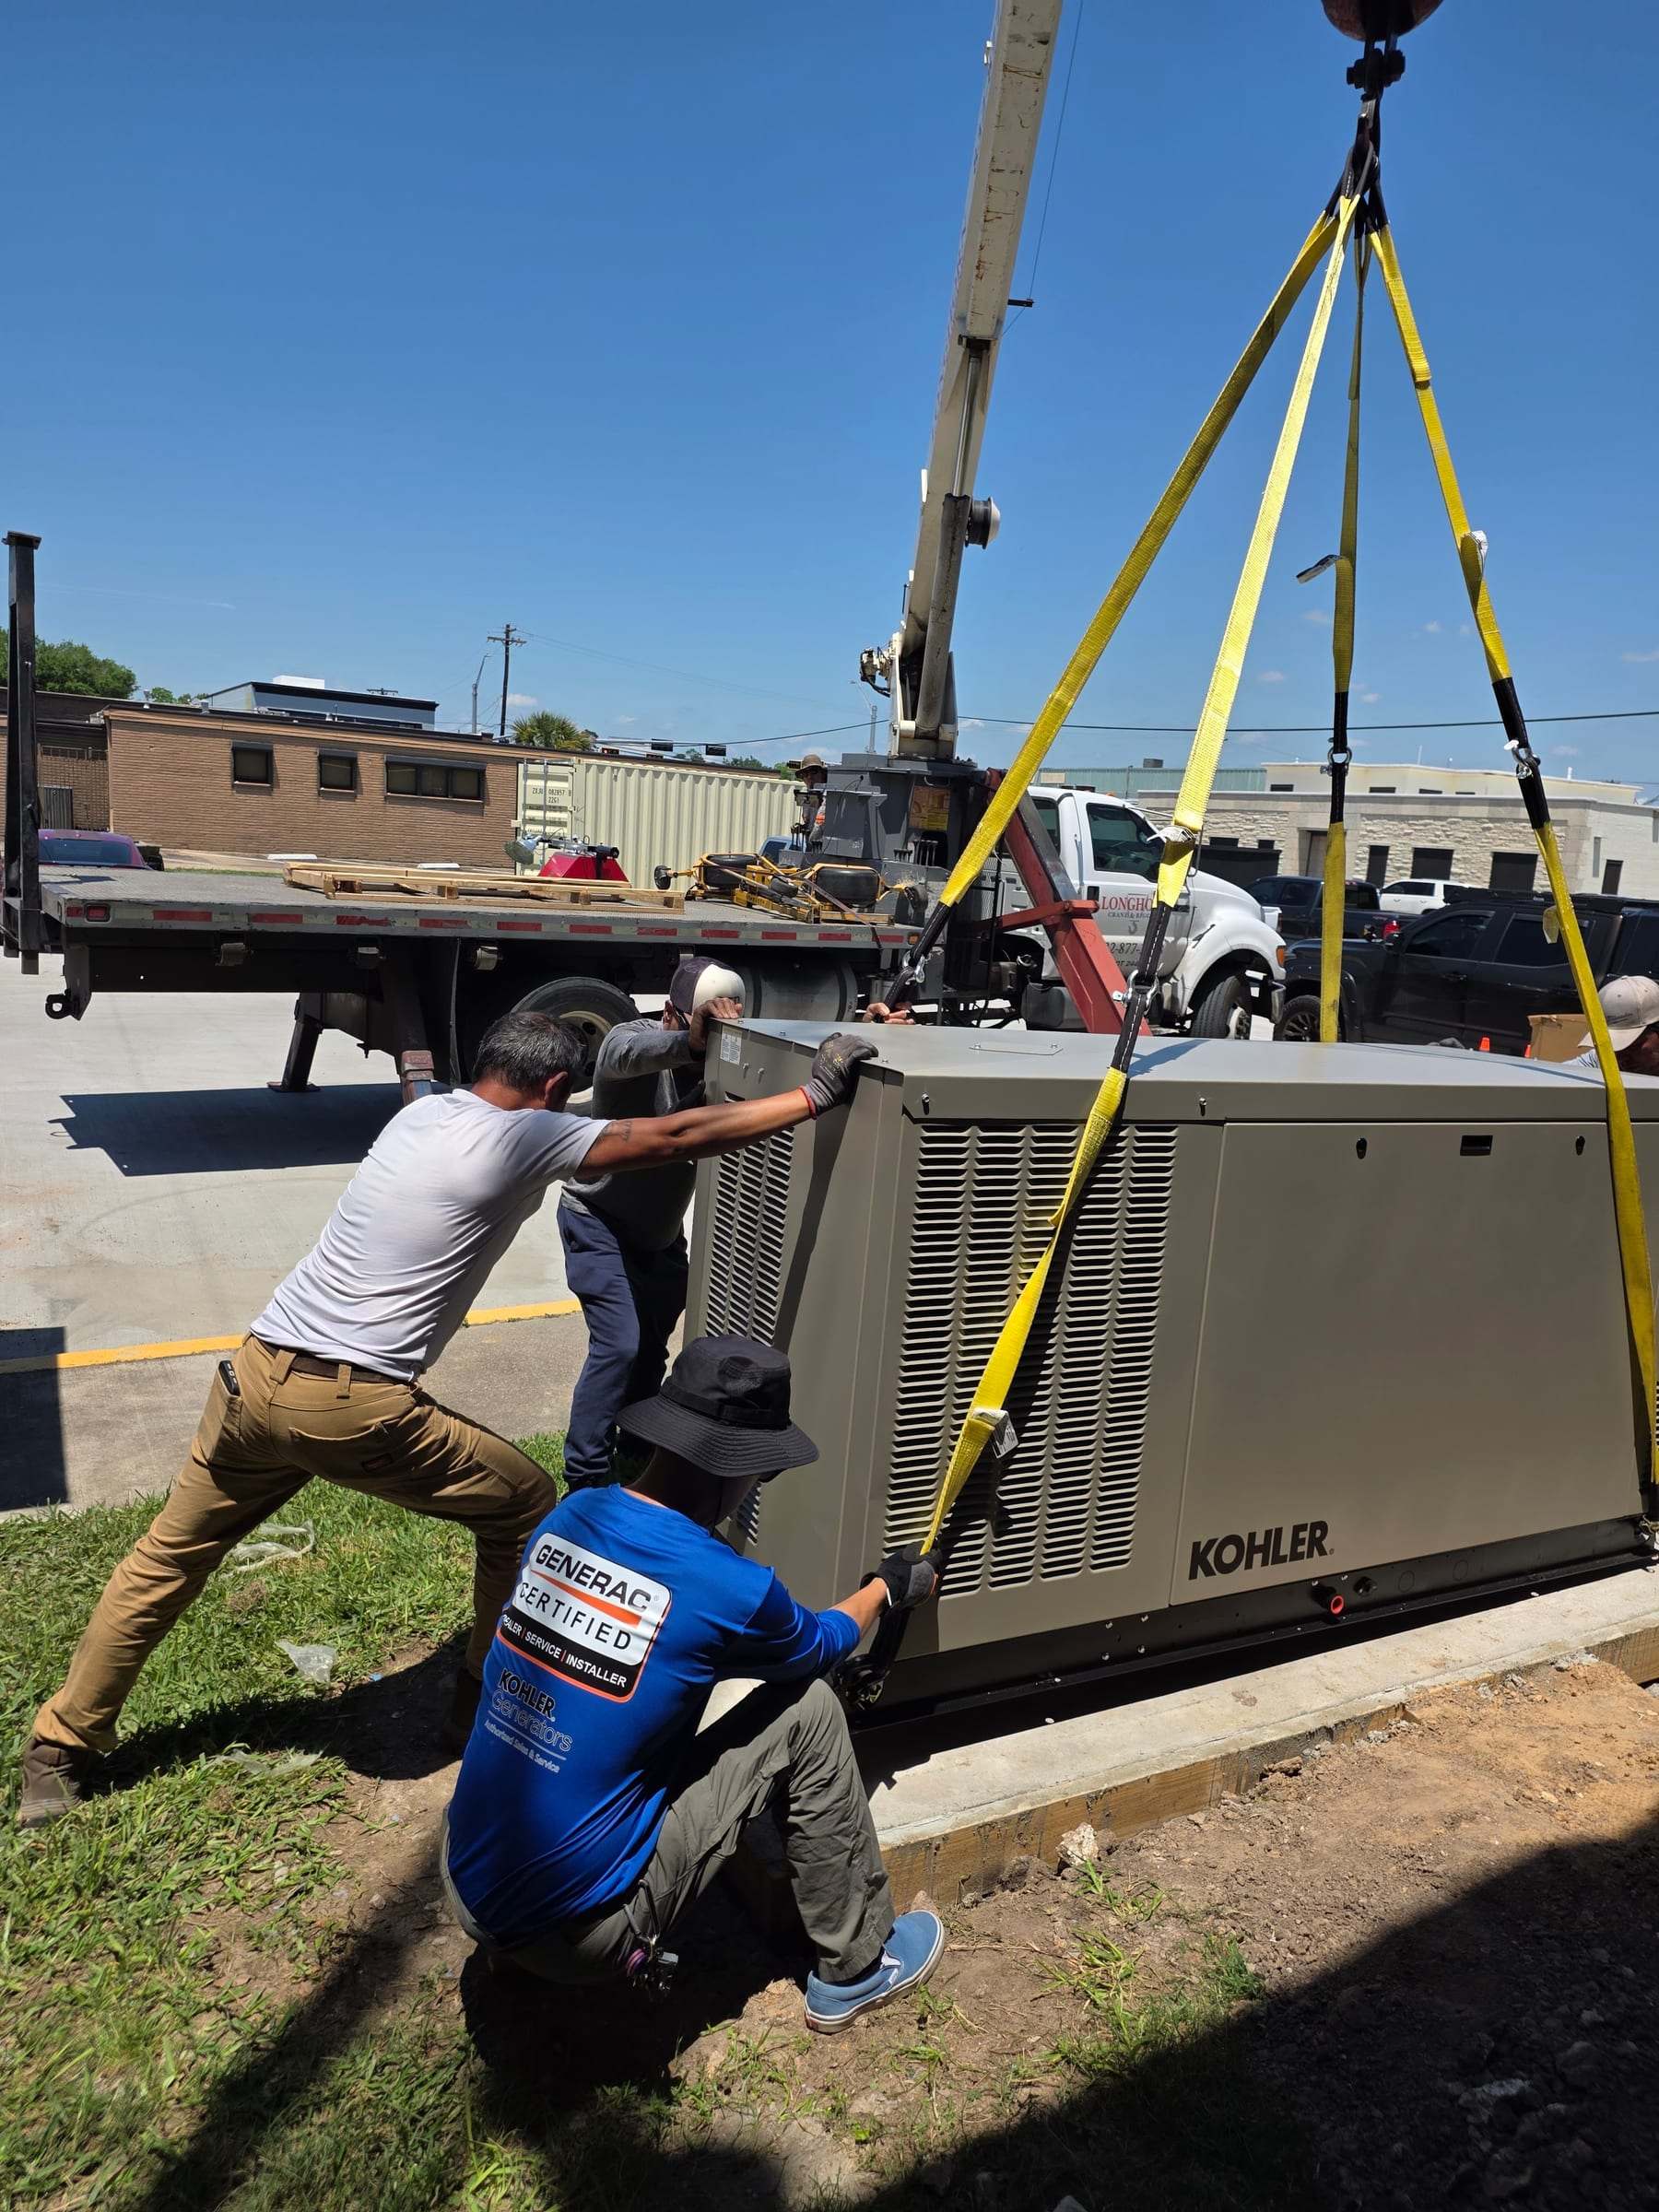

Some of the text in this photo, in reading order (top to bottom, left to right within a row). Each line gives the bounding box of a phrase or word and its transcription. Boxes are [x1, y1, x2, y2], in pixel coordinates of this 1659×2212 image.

[1101, 896, 1153, 911] LONGHO
[1105, 942, 1141, 954] 2-877-
[535, 1544, 652, 1613] GENERAC
[1188, 1520, 1329, 1580] KOHLER
[519, 1583, 632, 1650] CERTIFIED
[524, 1630, 562, 1659] SERVICE
[566, 1653, 628, 1688] INSTALLER
[492, 1689, 573, 1752] Generators
[498, 1668, 555, 1719] KOHLER
[484, 1719, 560, 1773] Authorized Sales & Service
